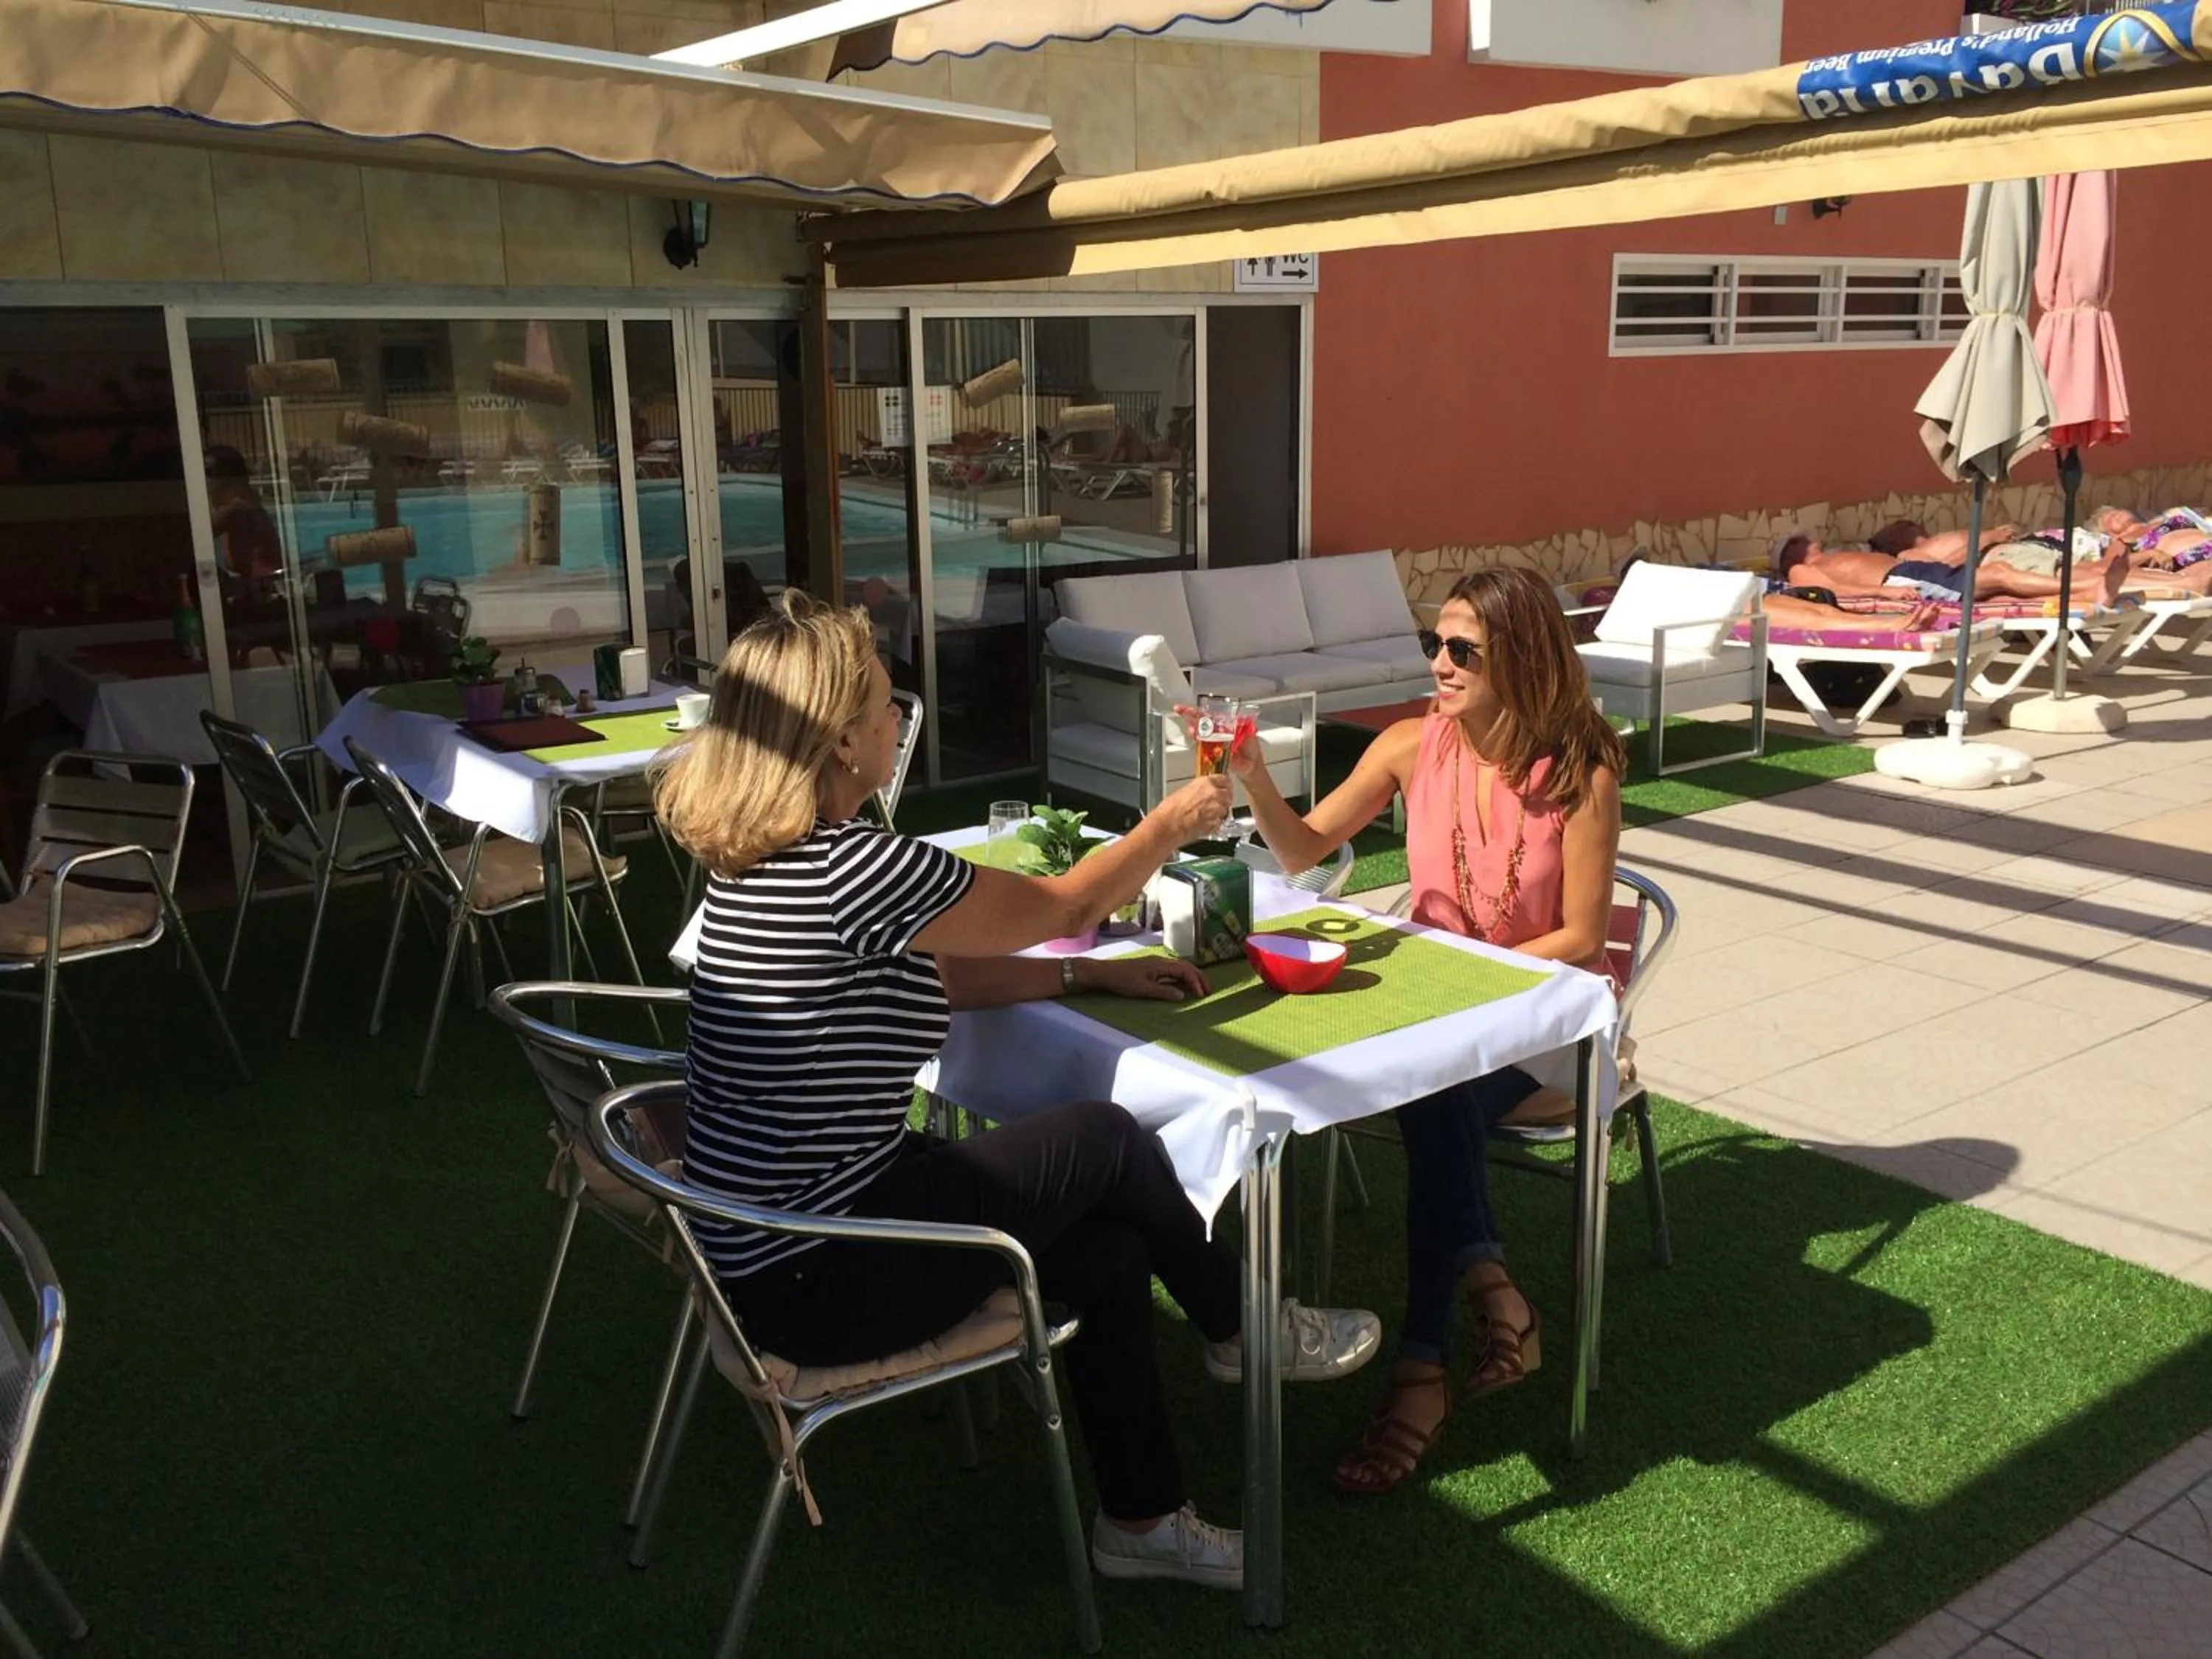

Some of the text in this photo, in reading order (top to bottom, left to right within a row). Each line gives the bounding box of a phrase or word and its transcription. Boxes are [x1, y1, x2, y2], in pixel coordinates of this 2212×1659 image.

[1802, 16, 2082, 74] Holland's Premium Beer
